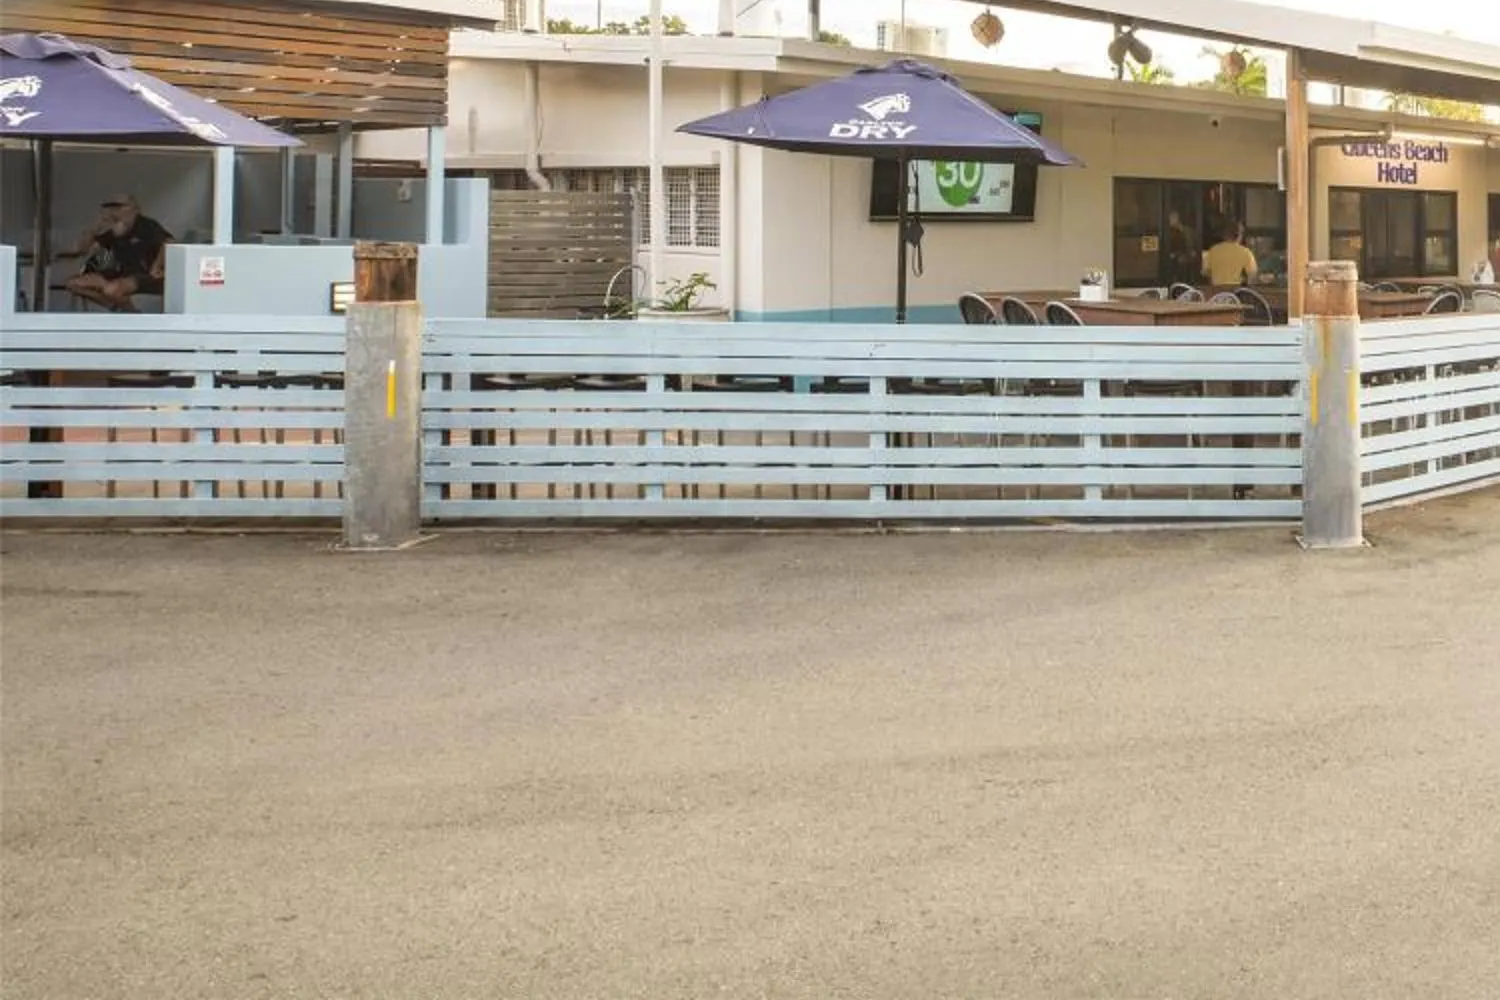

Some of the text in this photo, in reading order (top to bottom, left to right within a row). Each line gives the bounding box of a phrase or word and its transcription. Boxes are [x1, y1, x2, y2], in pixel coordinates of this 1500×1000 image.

[828, 122, 918, 139] DRY
[1404, 140, 1449, 163] Beach
[1377, 162, 1418, 184] Hotel
